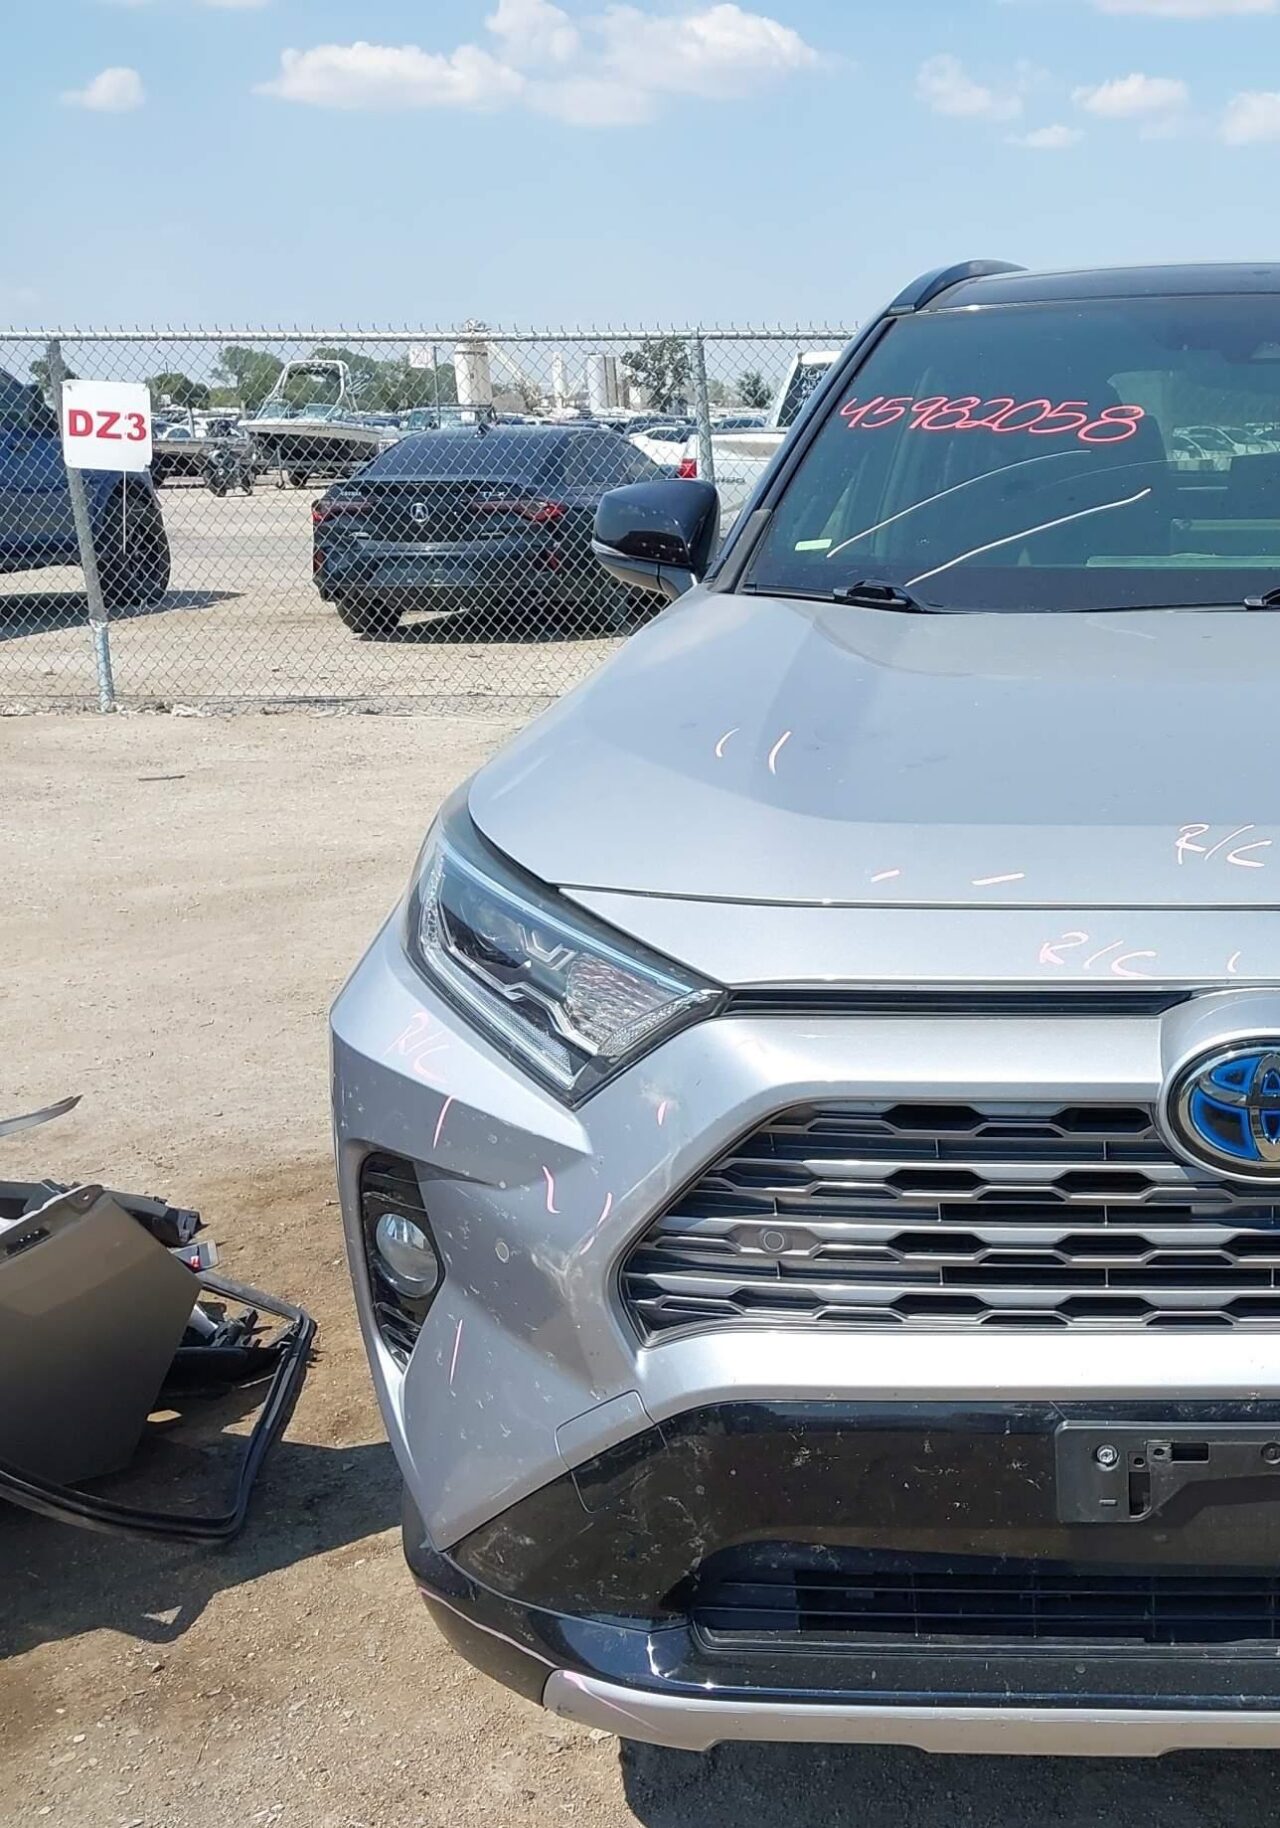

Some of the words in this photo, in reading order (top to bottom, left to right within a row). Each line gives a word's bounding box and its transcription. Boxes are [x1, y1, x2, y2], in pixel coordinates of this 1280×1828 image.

[68, 409, 147, 441] DZ3
[840, 396, 1145, 443] 45982058
[1175, 823, 1273, 867] R/C
[1038, 930, 1157, 978] R/C
